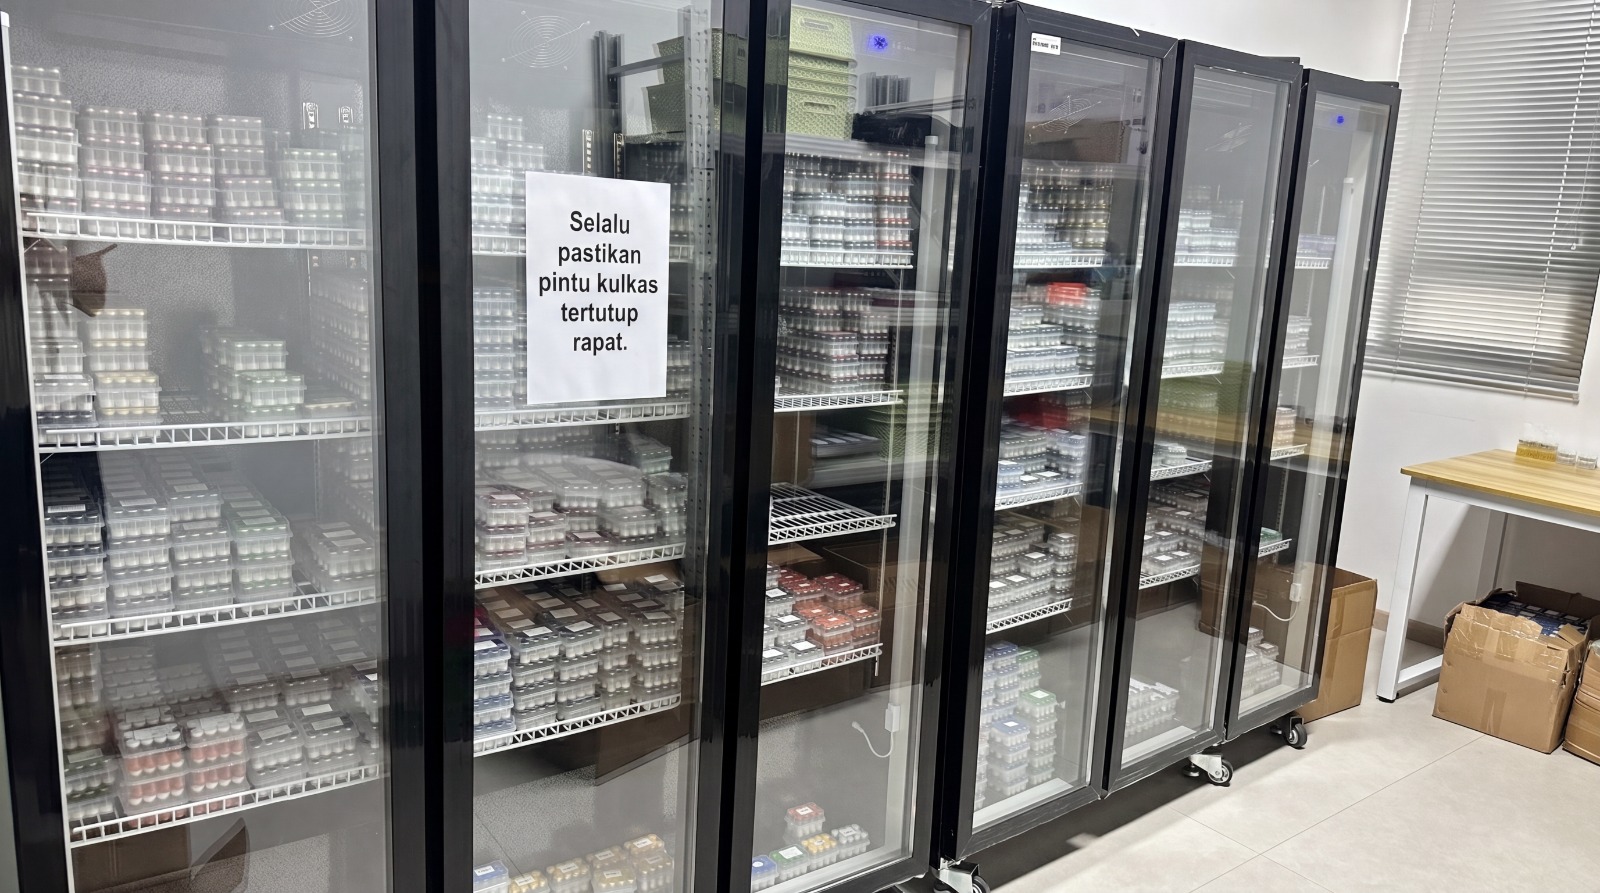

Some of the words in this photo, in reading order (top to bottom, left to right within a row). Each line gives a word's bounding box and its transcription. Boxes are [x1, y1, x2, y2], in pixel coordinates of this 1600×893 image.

[569, 210, 630, 235] Selalu
[558, 243, 641, 267] pastikan
[539, 271, 590, 297] pintu
[597, 272, 659, 294] kulkas
[560, 302, 639, 327] tertutup
[573, 332, 627, 357] rapat.
